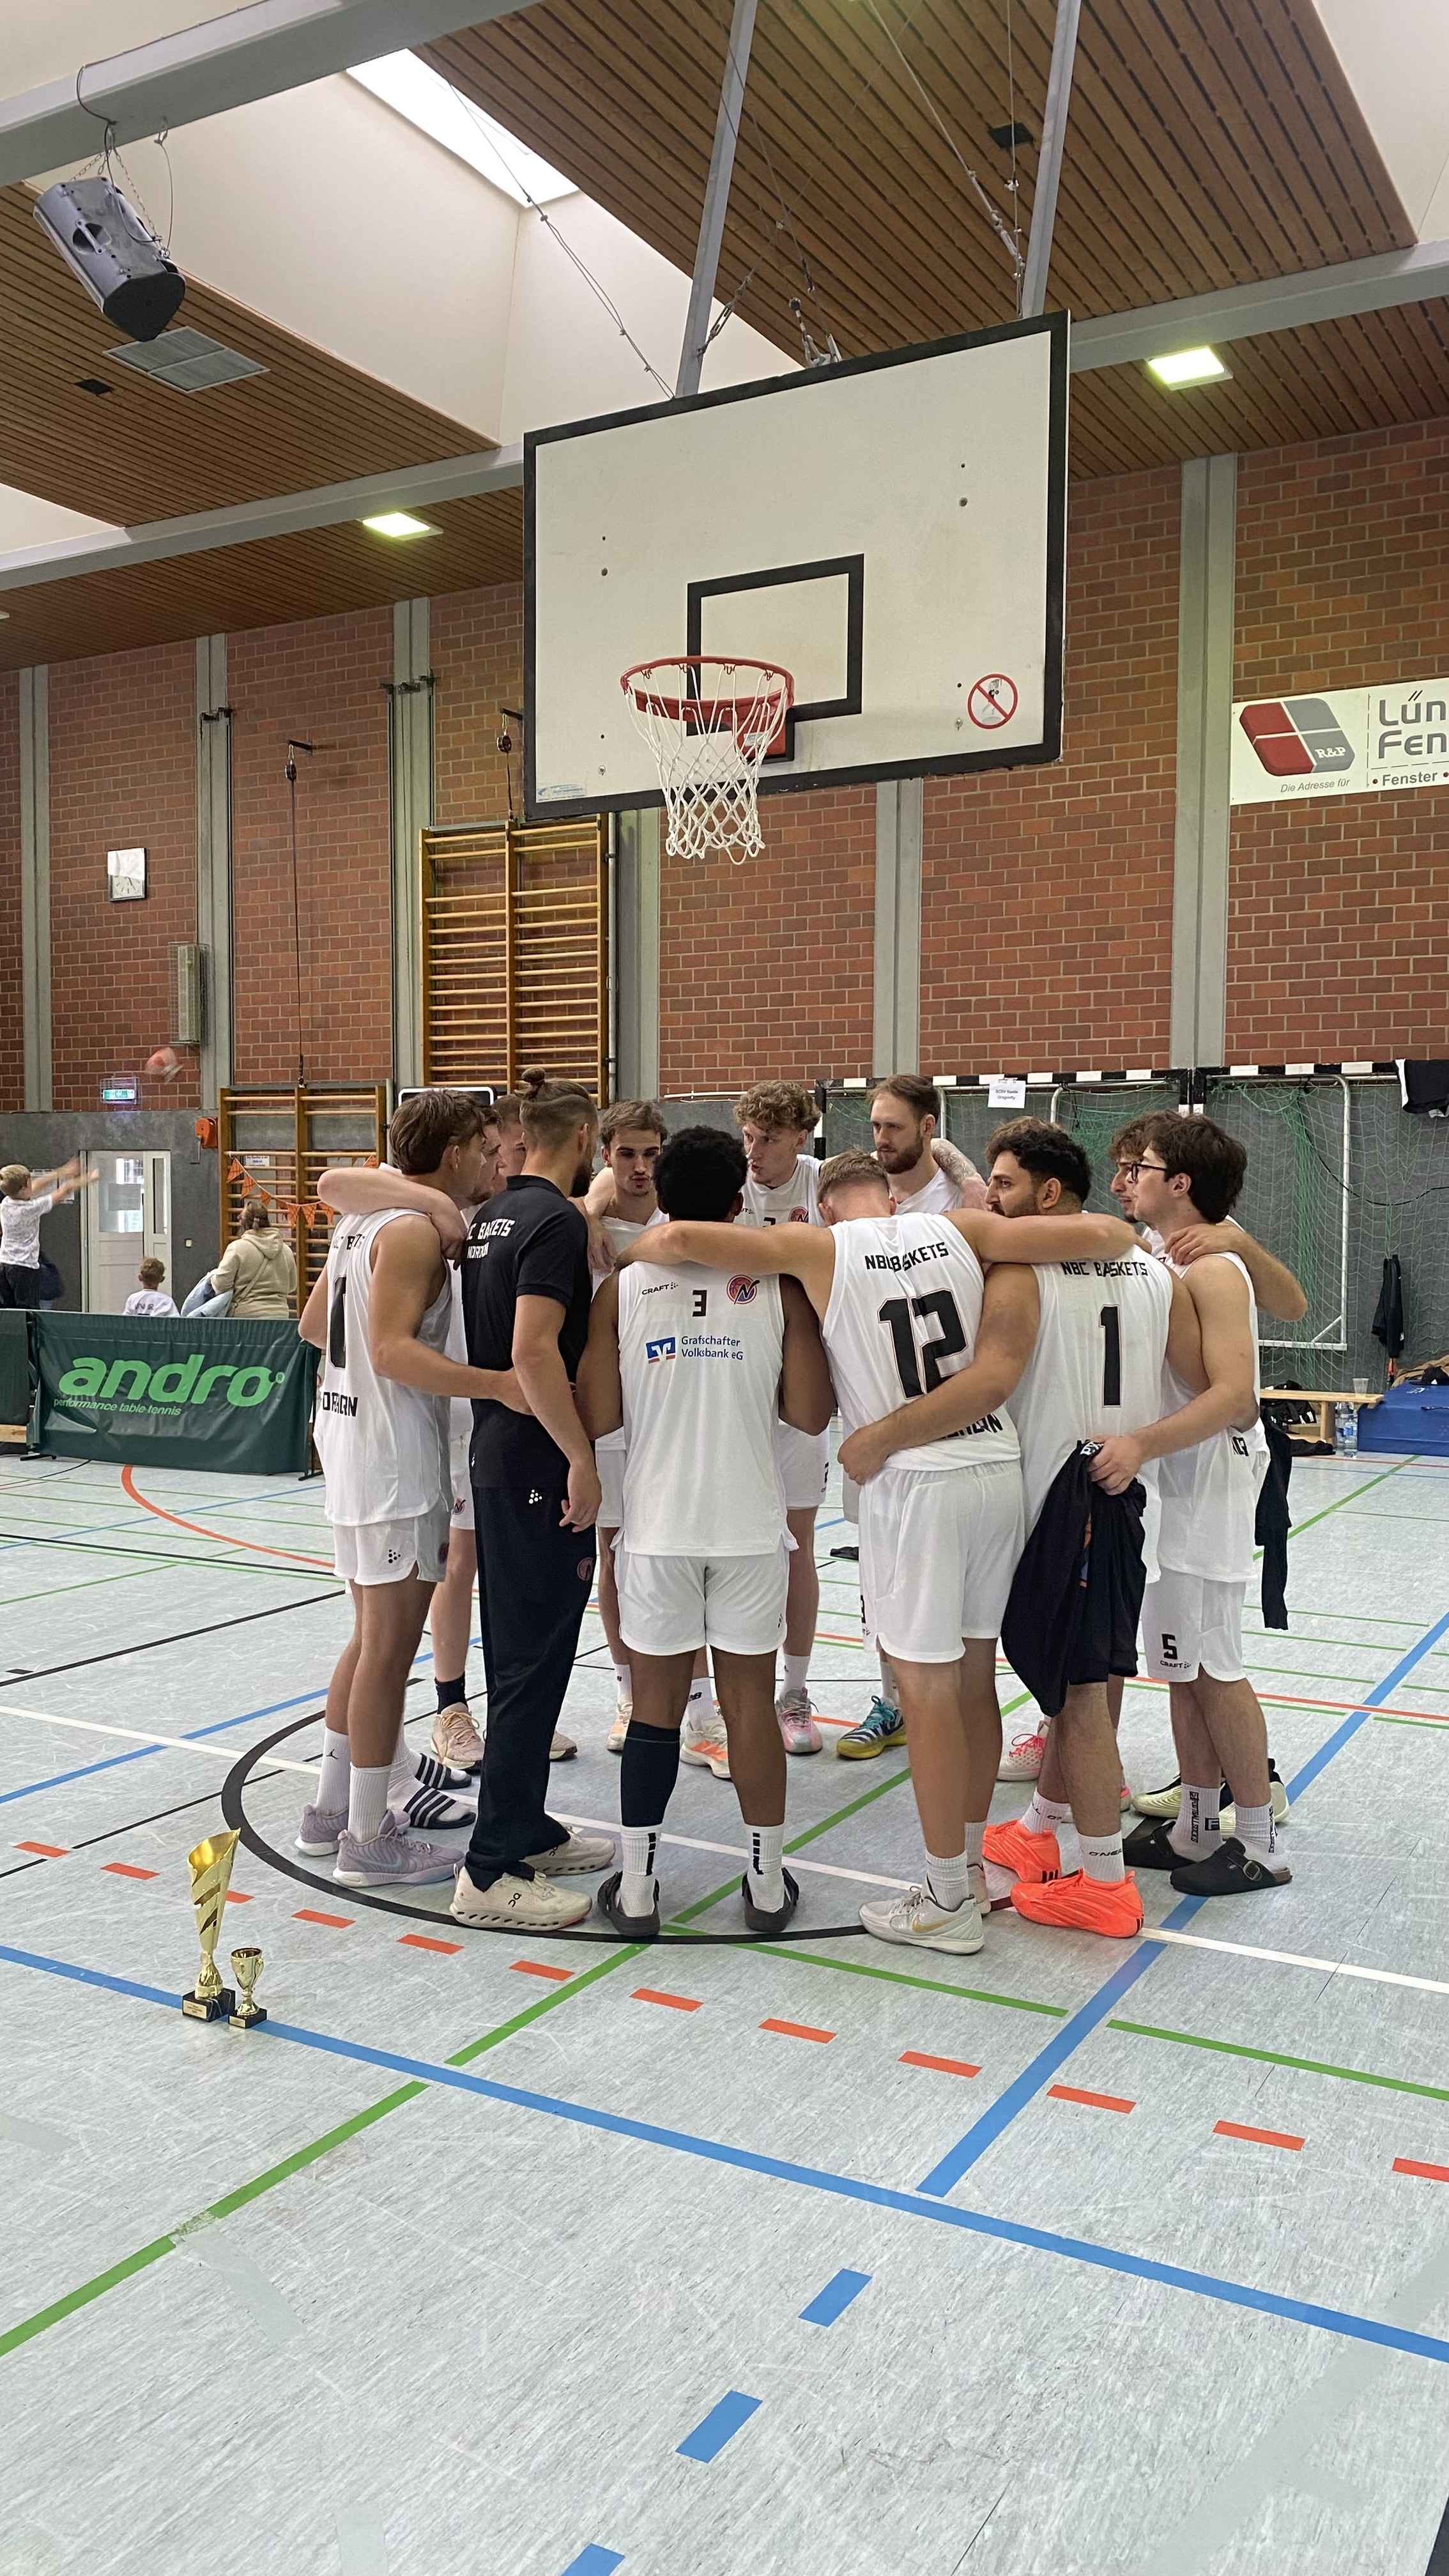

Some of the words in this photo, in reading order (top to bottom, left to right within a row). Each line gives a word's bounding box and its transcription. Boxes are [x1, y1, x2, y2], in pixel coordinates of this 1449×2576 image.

[1315, 746, 1346, 758] R&P
[1379, 730, 1447, 759] Fen
[1280, 783, 1296, 793] Die
[1298, 780, 1335, 792] Adresse
[1337, 778, 1351, 788] für
[1383, 772, 1438, 786] Fenster
[477, 1218, 516, 1239] BAKETS
[890, 1242, 949, 1273] BSKETS
[1061, 1262, 1089, 1275] NBC
[1095, 1261, 1148, 1276] BASKETS
[641, 1284, 670, 1295] CRAFT
[692, 1289, 707, 1317] 3
[681, 1335, 740, 1347] Grafschafter
[877, 1287, 969, 1400] 12
[681, 1348, 729, 1358] Volksbank
[731, 1351, 743, 1360] eG
[1099, 1304, 1122, 1408] 1
[59, 1354, 273, 1407] andro
[54, 1397, 118, 1412] performance
[119, 1402, 146, 1413] table
[148, 1406, 181, 1416] tennis
[1162, 1633, 1178, 1660] 5
[1160, 1660, 1183, 1669] CRAFT
